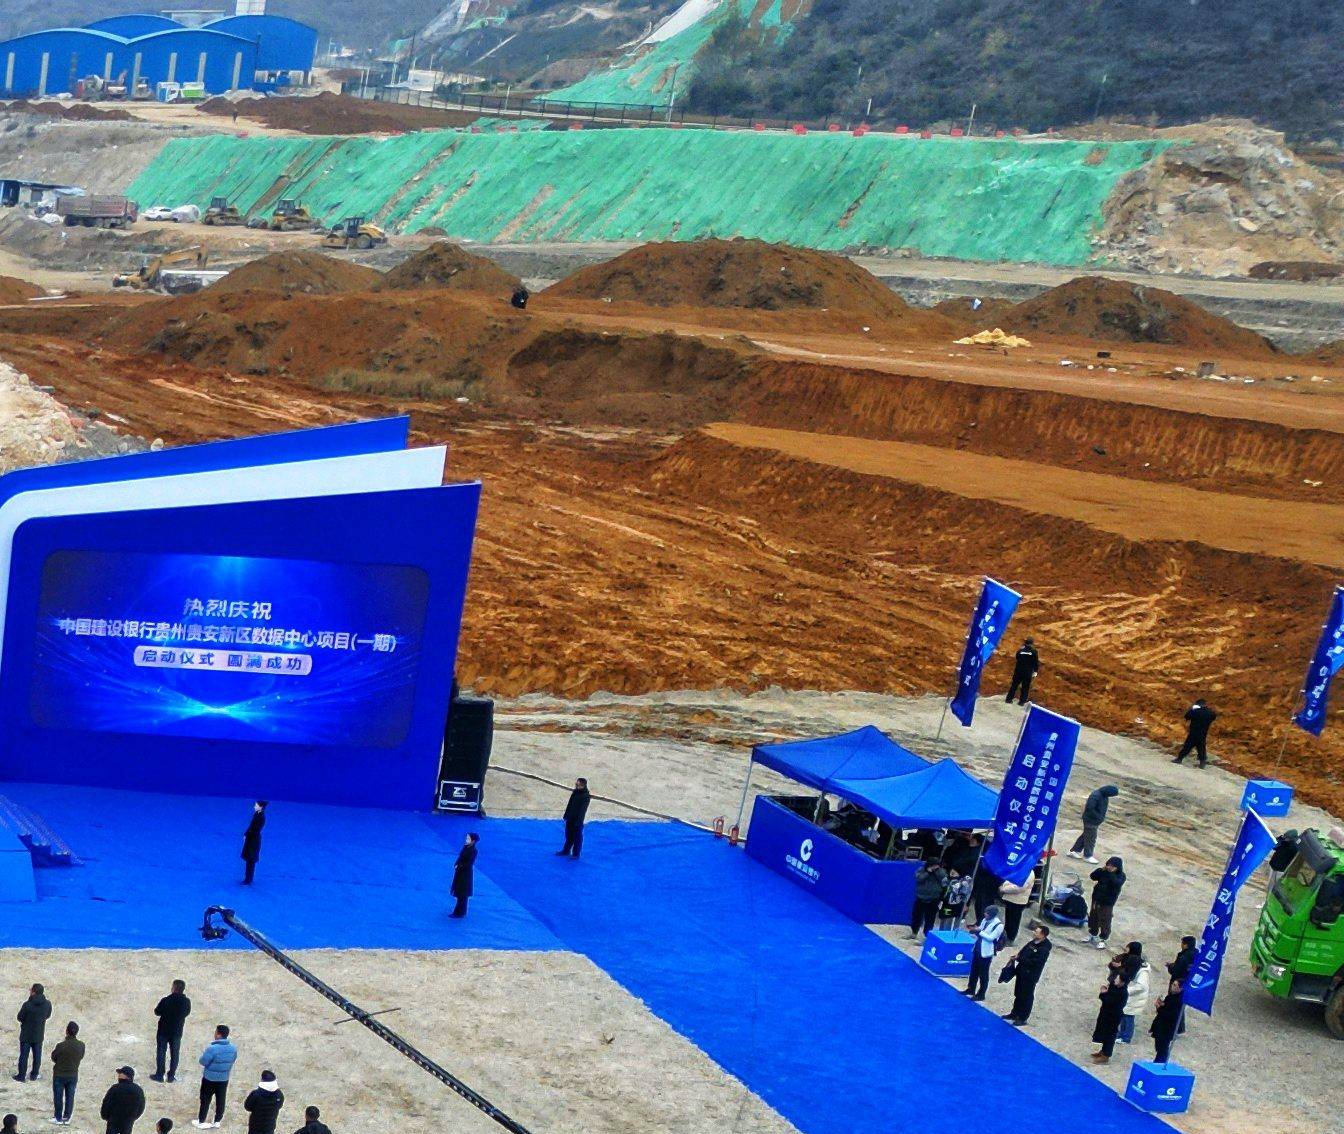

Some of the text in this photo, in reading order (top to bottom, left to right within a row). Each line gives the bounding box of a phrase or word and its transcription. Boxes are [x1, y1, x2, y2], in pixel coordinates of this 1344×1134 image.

[183, 598, 272, 621] 热烈庆祝
[142, 649, 302, 671] 启动仪式 圆满成功
